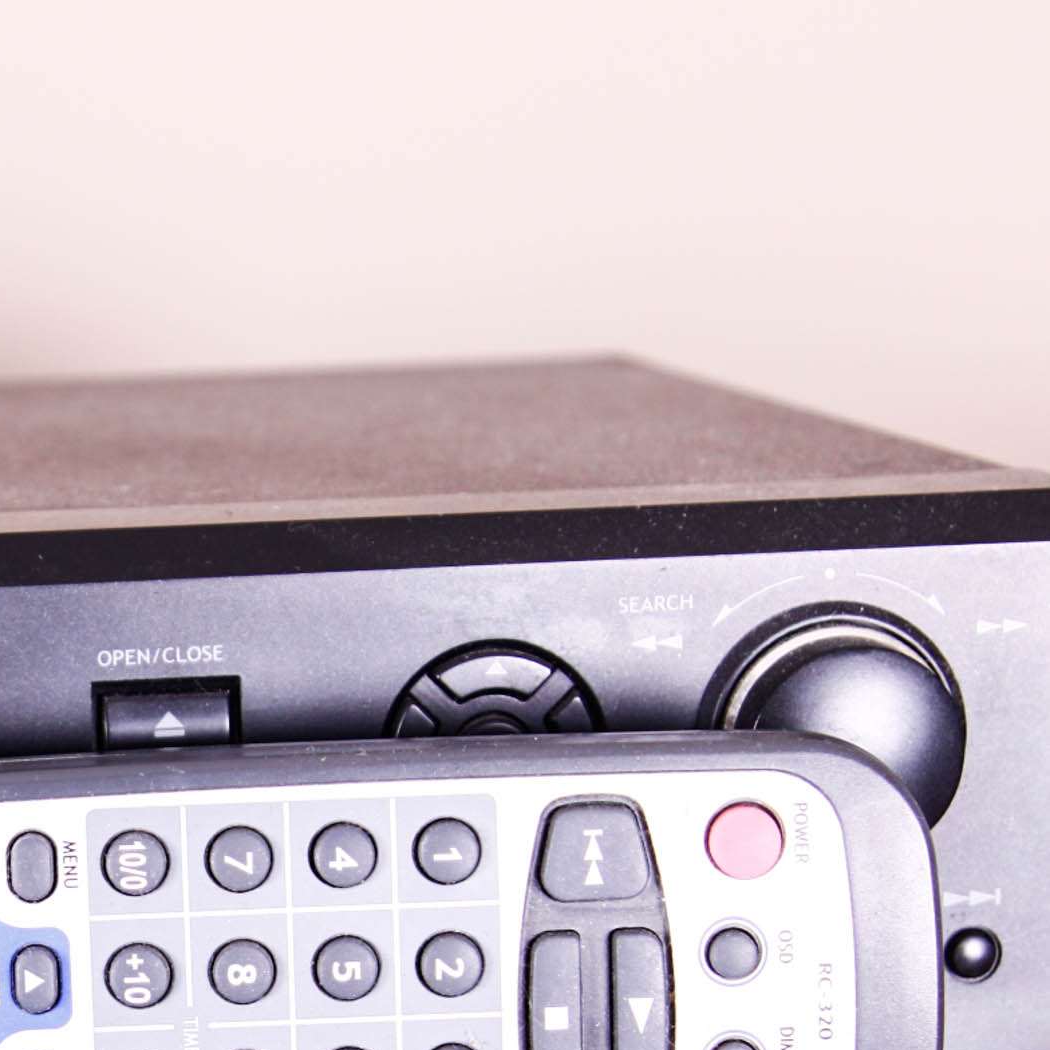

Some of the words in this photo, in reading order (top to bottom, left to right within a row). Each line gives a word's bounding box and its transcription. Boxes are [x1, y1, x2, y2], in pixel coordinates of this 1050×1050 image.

[618, 594, 694, 614] SEARCH
[98, 644, 223, 667] OPEN/CLOSE
[794, 803, 809, 863] POWER
[62, 841, 79, 889] MENU
[119, 841, 147, 889] 10/0
[224, 852, 253, 874] 7
[329, 847, 358, 871] 4
[434, 848, 463, 861] 1
[779, 930, 793, 963] OSD
[124, 954, 151, 1003] +10
[228, 964, 257, 985] 8
[333, 962, 361, 982] 5
[436, 958, 464, 980] 2
